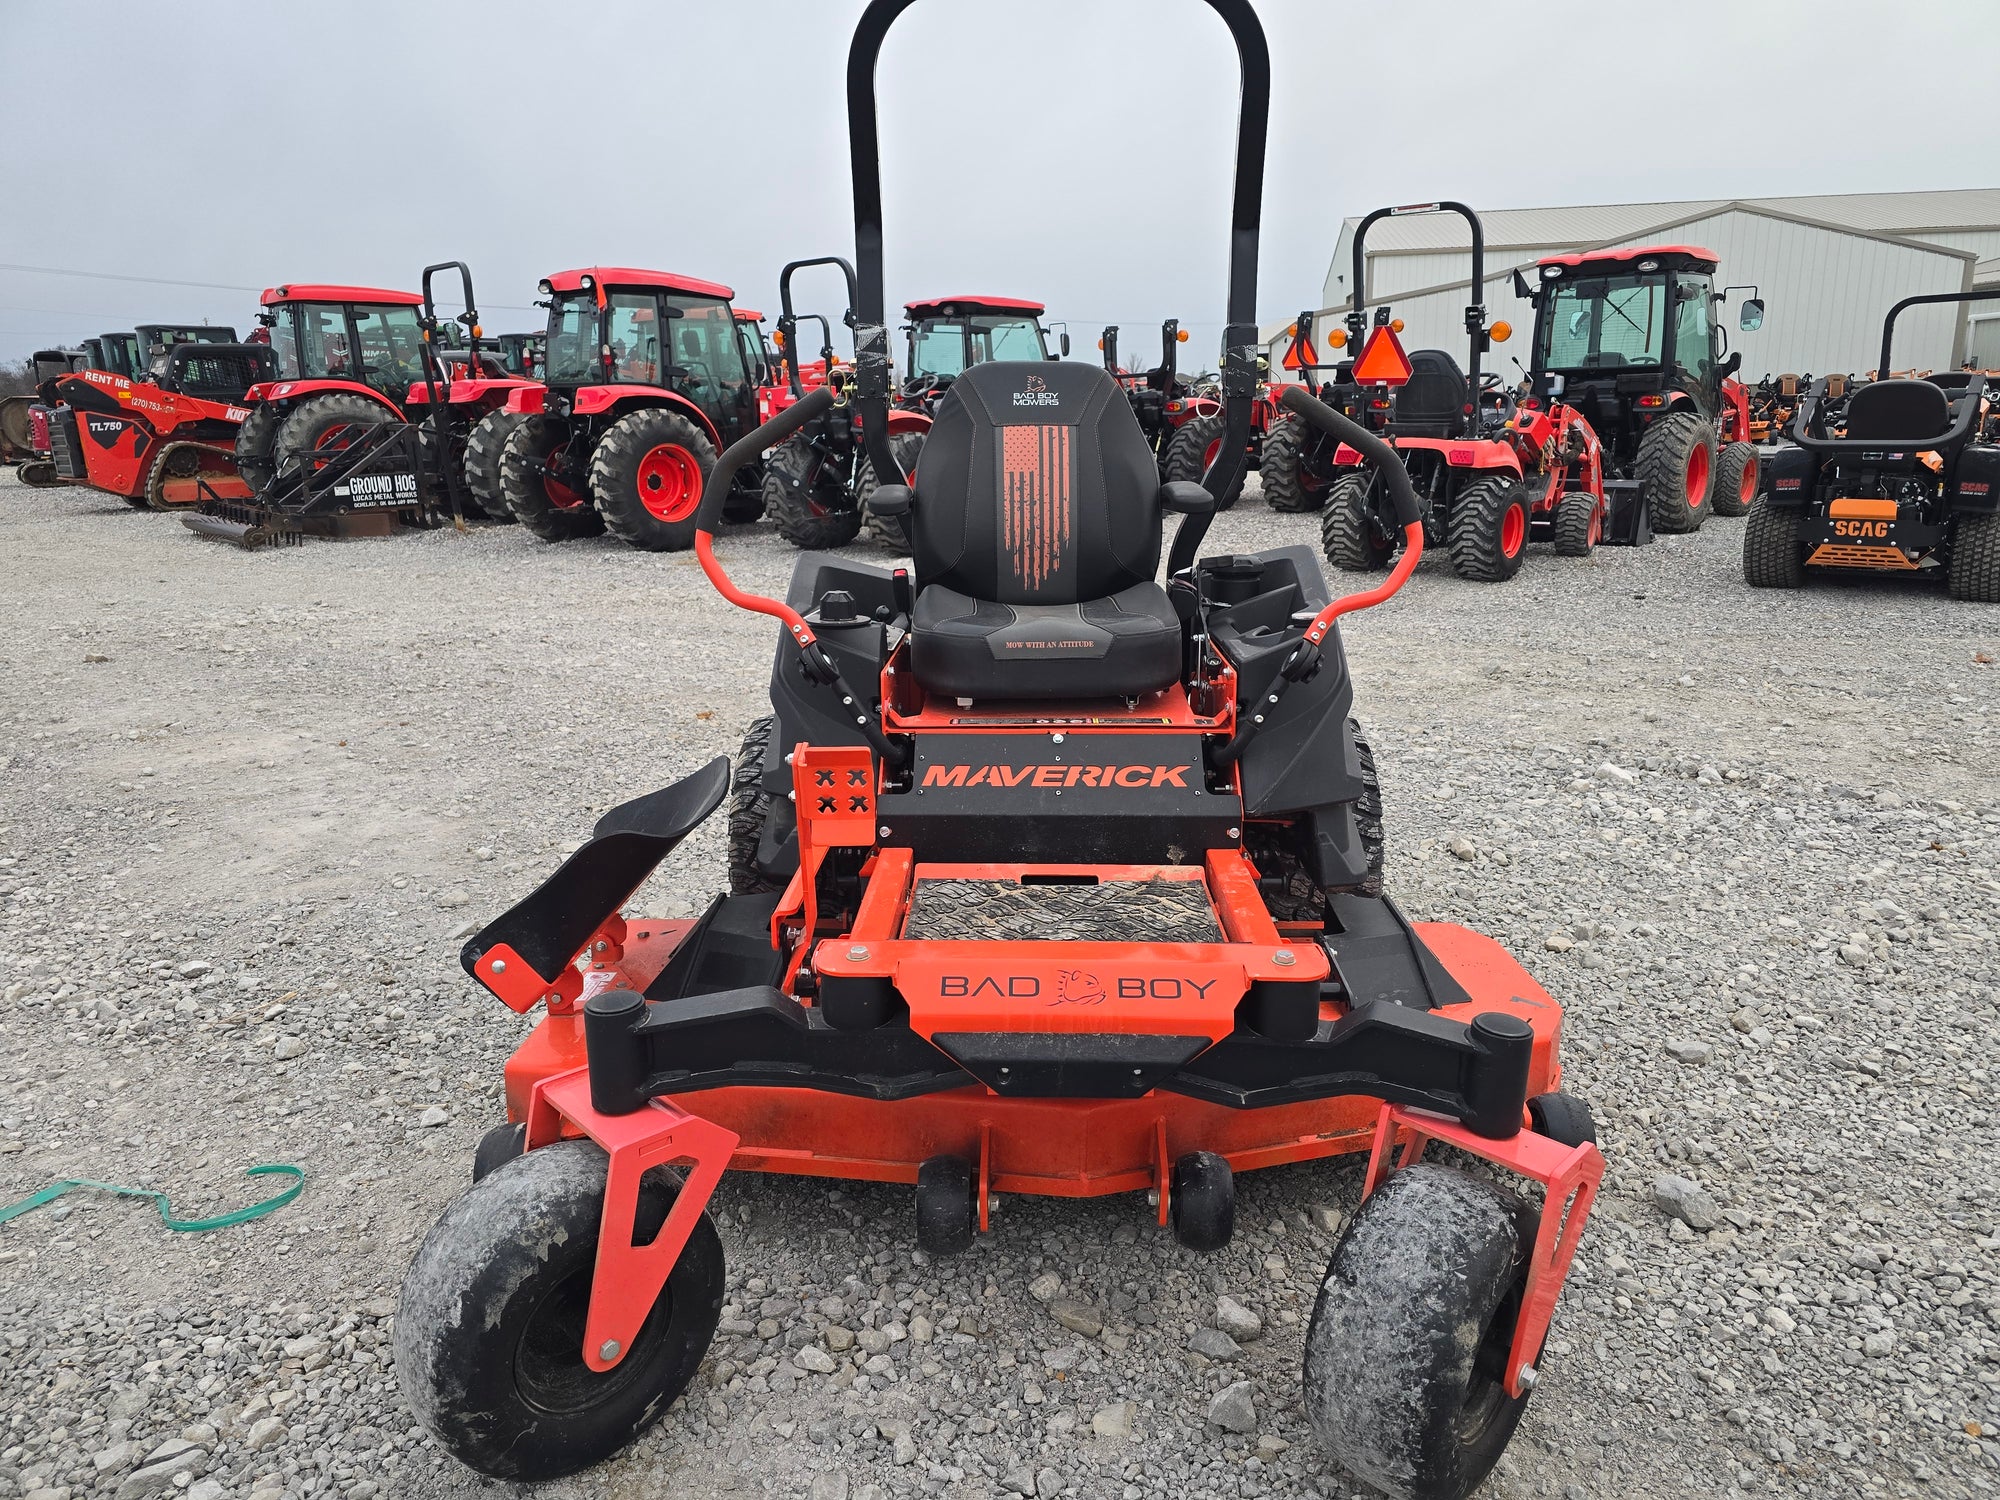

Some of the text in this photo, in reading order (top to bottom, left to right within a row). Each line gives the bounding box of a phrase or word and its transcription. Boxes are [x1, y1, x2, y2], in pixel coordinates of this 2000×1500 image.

[85, 372, 130, 389] RENT ME
[131, 397, 148, 409] (270)
[90, 422, 122, 431] TL750
[349, 475, 392, 495] GROUND
[394, 474, 416, 492] HOG
[1775, 478, 1800, 487] SCAG
[1960, 482, 1989, 492] SCAG
[352, 491, 418, 502] LUCAS METAL WORKS
[1834, 520, 1888, 538] SCAG
[921, 764, 1193, 788] MAVERICK
[940, 976, 1217, 999] BAD BOY
